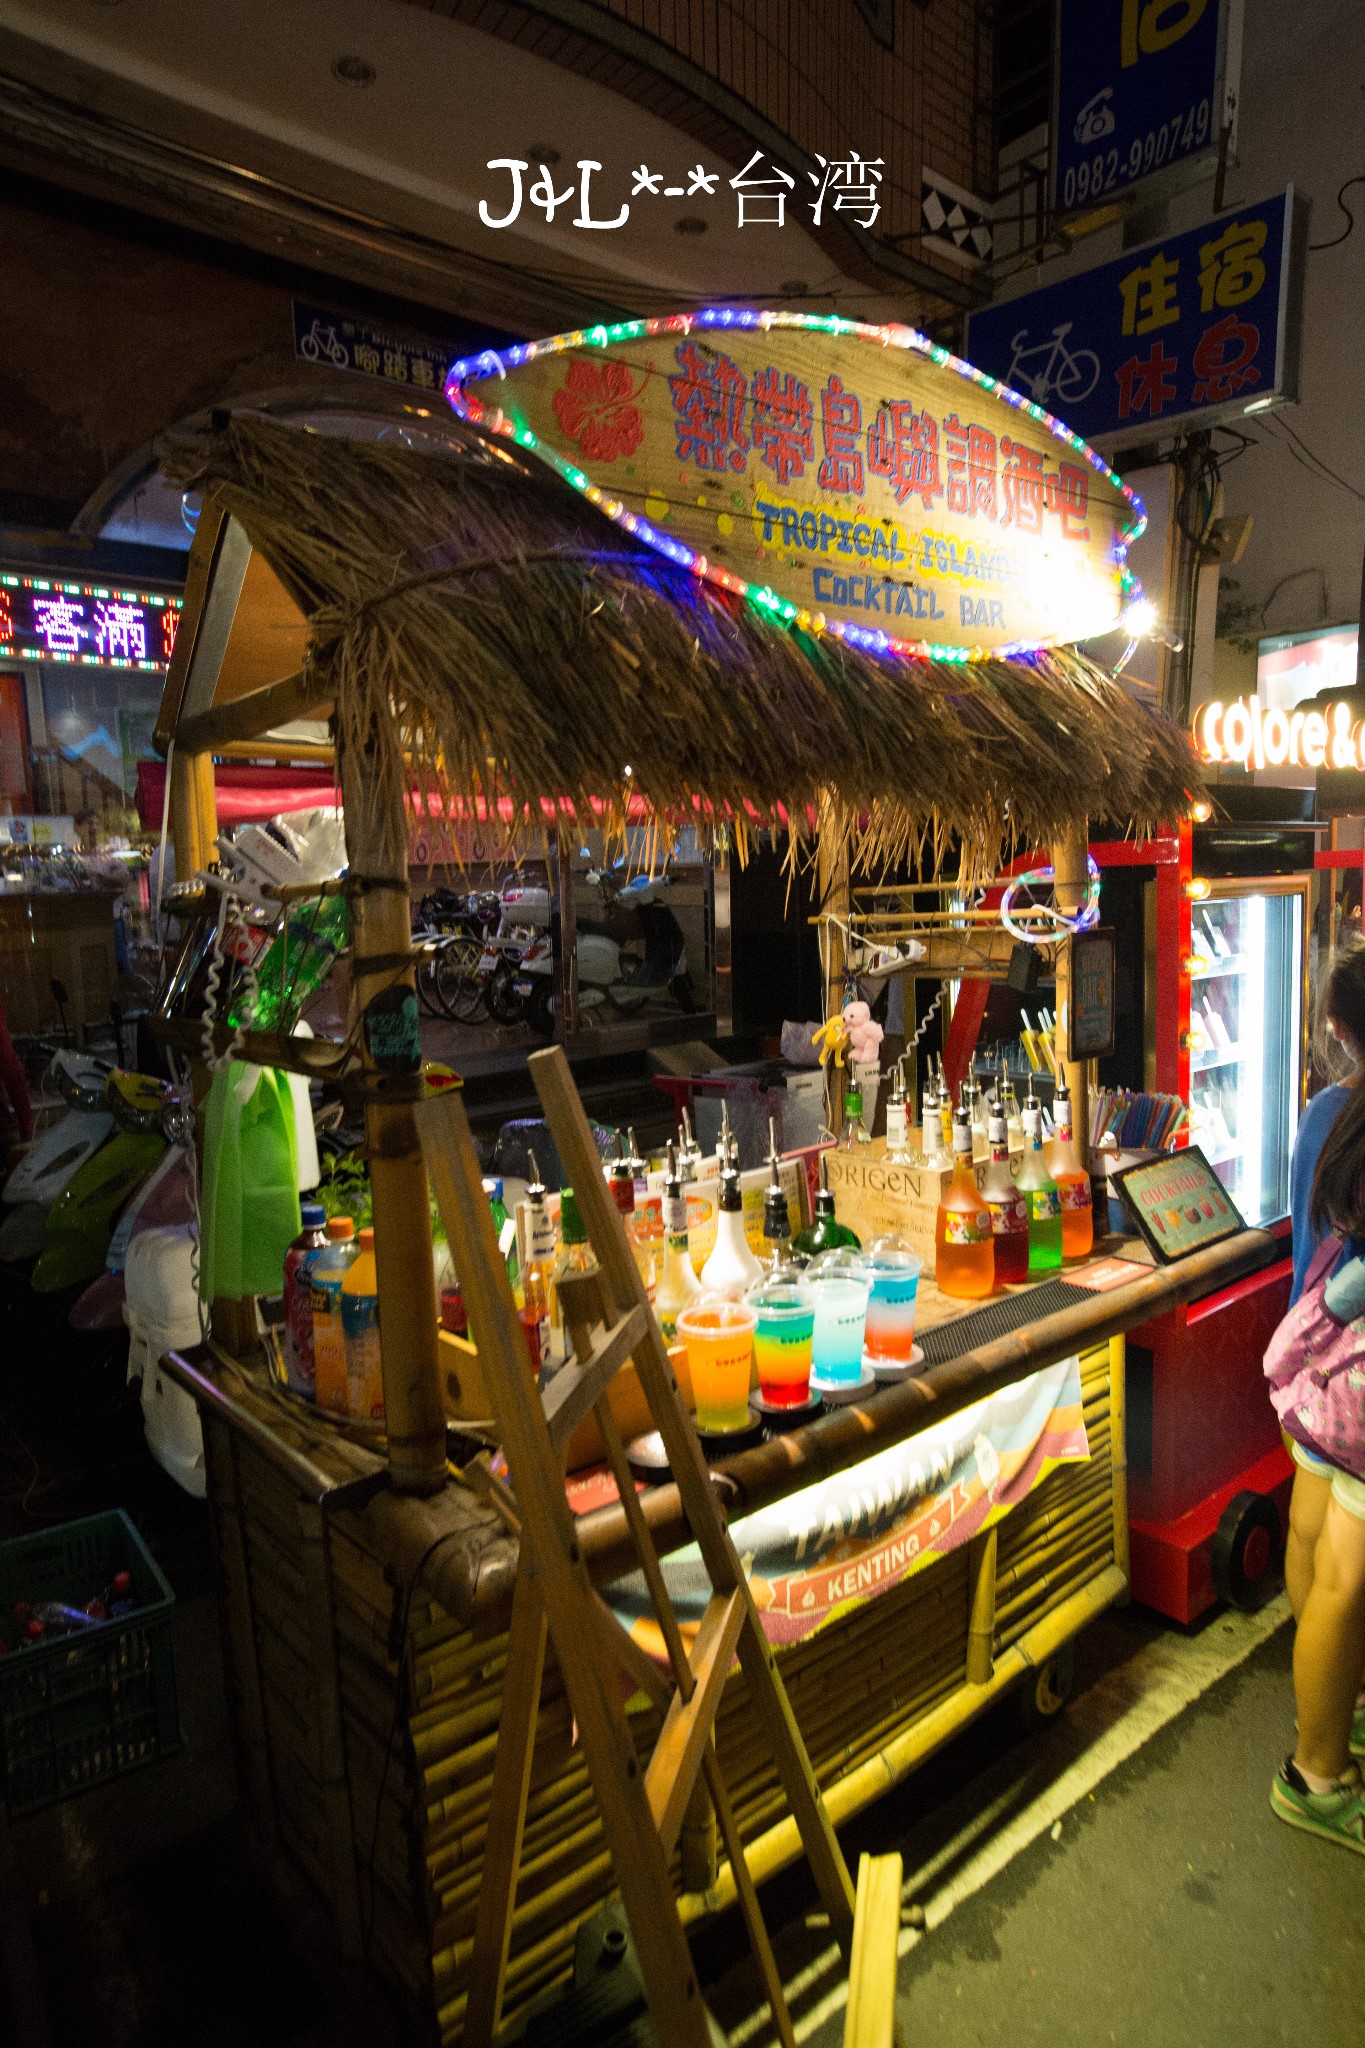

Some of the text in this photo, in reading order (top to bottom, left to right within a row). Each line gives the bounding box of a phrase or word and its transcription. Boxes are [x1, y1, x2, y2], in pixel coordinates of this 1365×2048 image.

[1064, 98, 1209, 208] 0982-990749
[1118, 220, 1268, 337] 住宿
[1115, 313, 1261, 418] 休息
[668, 340, 1091, 543] 熱帶島嶼調酒吧
[757, 501, 906, 562] TROPICAL
[33, 596, 146, 658] 客滿
[812, 566, 1007, 631] COCKTAIL BAR
[1140, 1172, 1208, 1207] COCKTAILS
[788, 1443, 955, 1562] TAIWAN
[827, 1534, 920, 1602] KENTING
